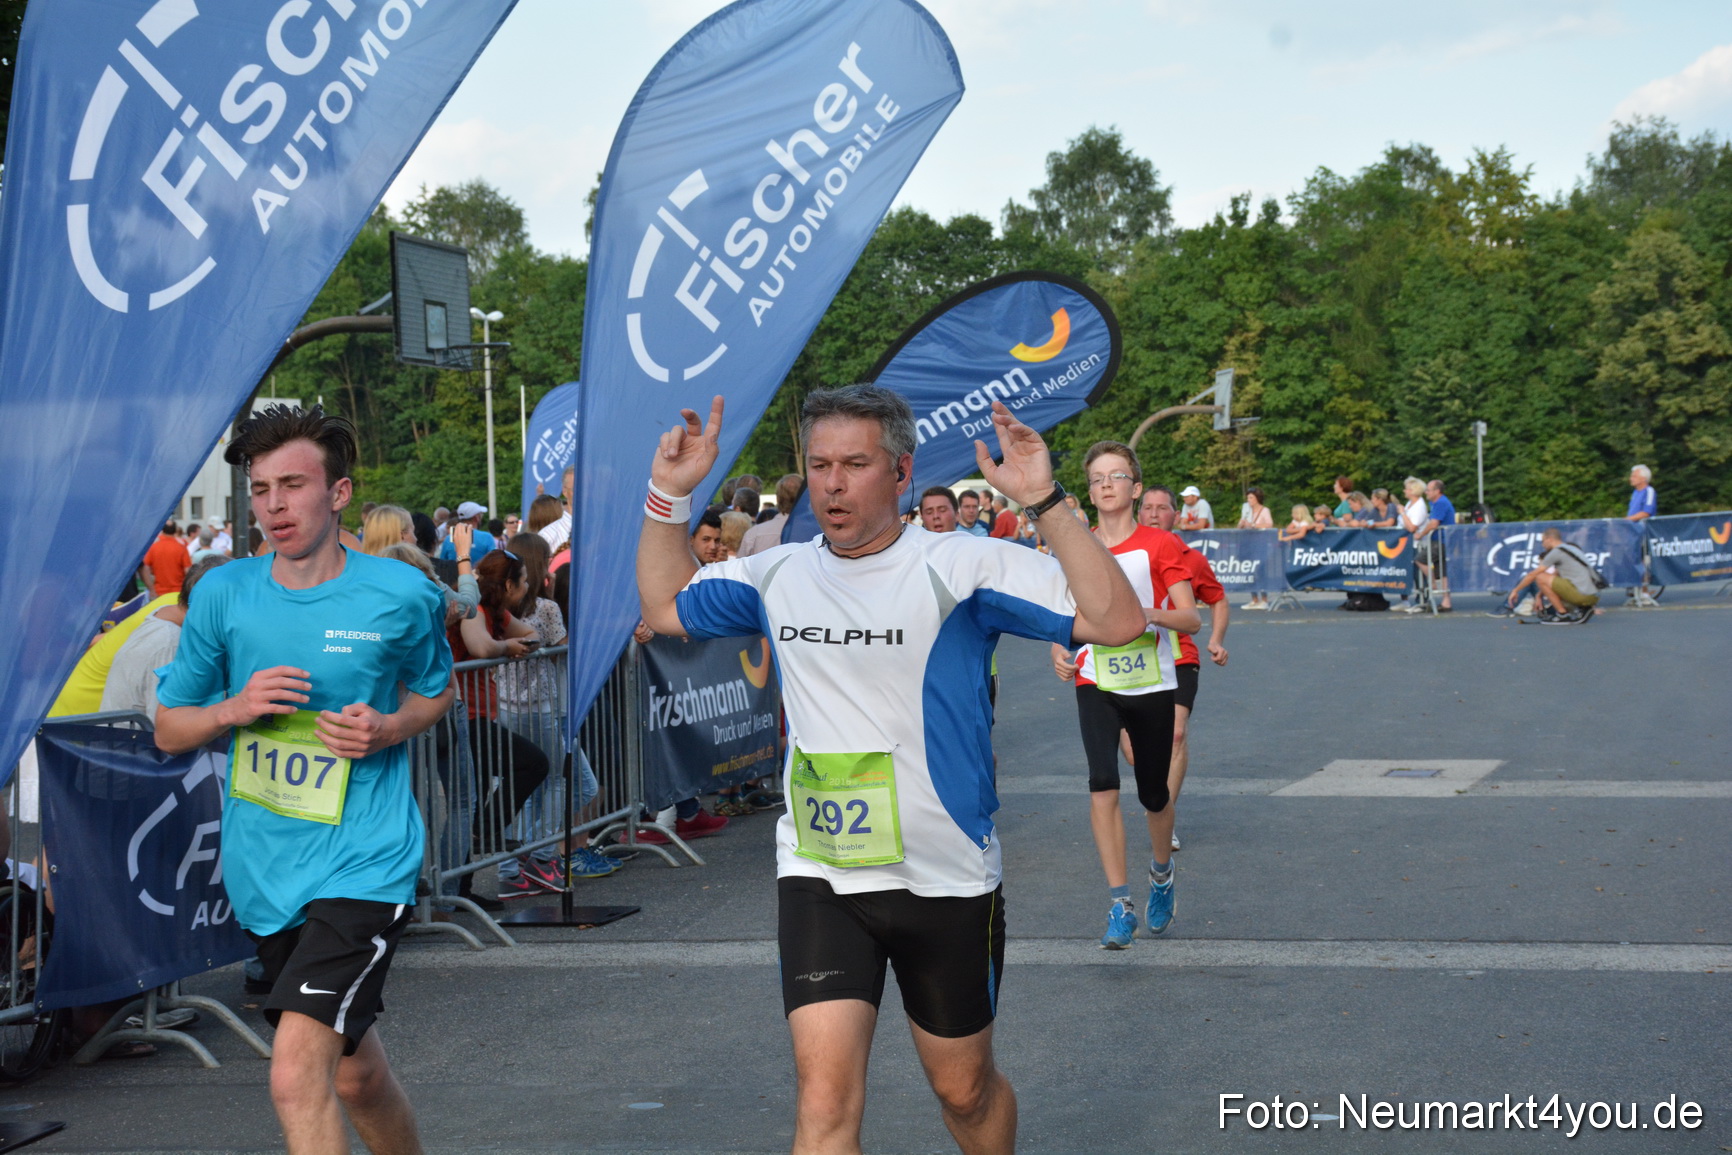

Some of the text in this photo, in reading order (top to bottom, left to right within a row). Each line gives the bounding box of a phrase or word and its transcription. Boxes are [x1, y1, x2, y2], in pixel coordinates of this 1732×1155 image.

[142, 0, 356, 240] Fisc
[252, 0, 428, 235] AUTOMO
[674, 41, 874, 333] Fischer
[748, 93, 900, 328] AUTOMOBILE
[1011, 389, 1042, 410] und
[1042, 353, 1100, 395] Medien
[543, 410, 578, 470] Fisch
[1293, 547, 1378, 567] Frischmann
[323, 644, 352, 653] Jonas
[335, 630, 381, 641] PFLEIDERER
[779, 626, 903, 645] DELPHI
[1108, 652, 1147, 674] 534
[649, 677, 750, 732] Frischmann
[713, 720, 736, 745] Druck
[737, 714, 752, 738] und
[247, 741, 337, 789] 1107
[806, 796, 872, 836] 292
[838, 843, 866, 851] Niebler
